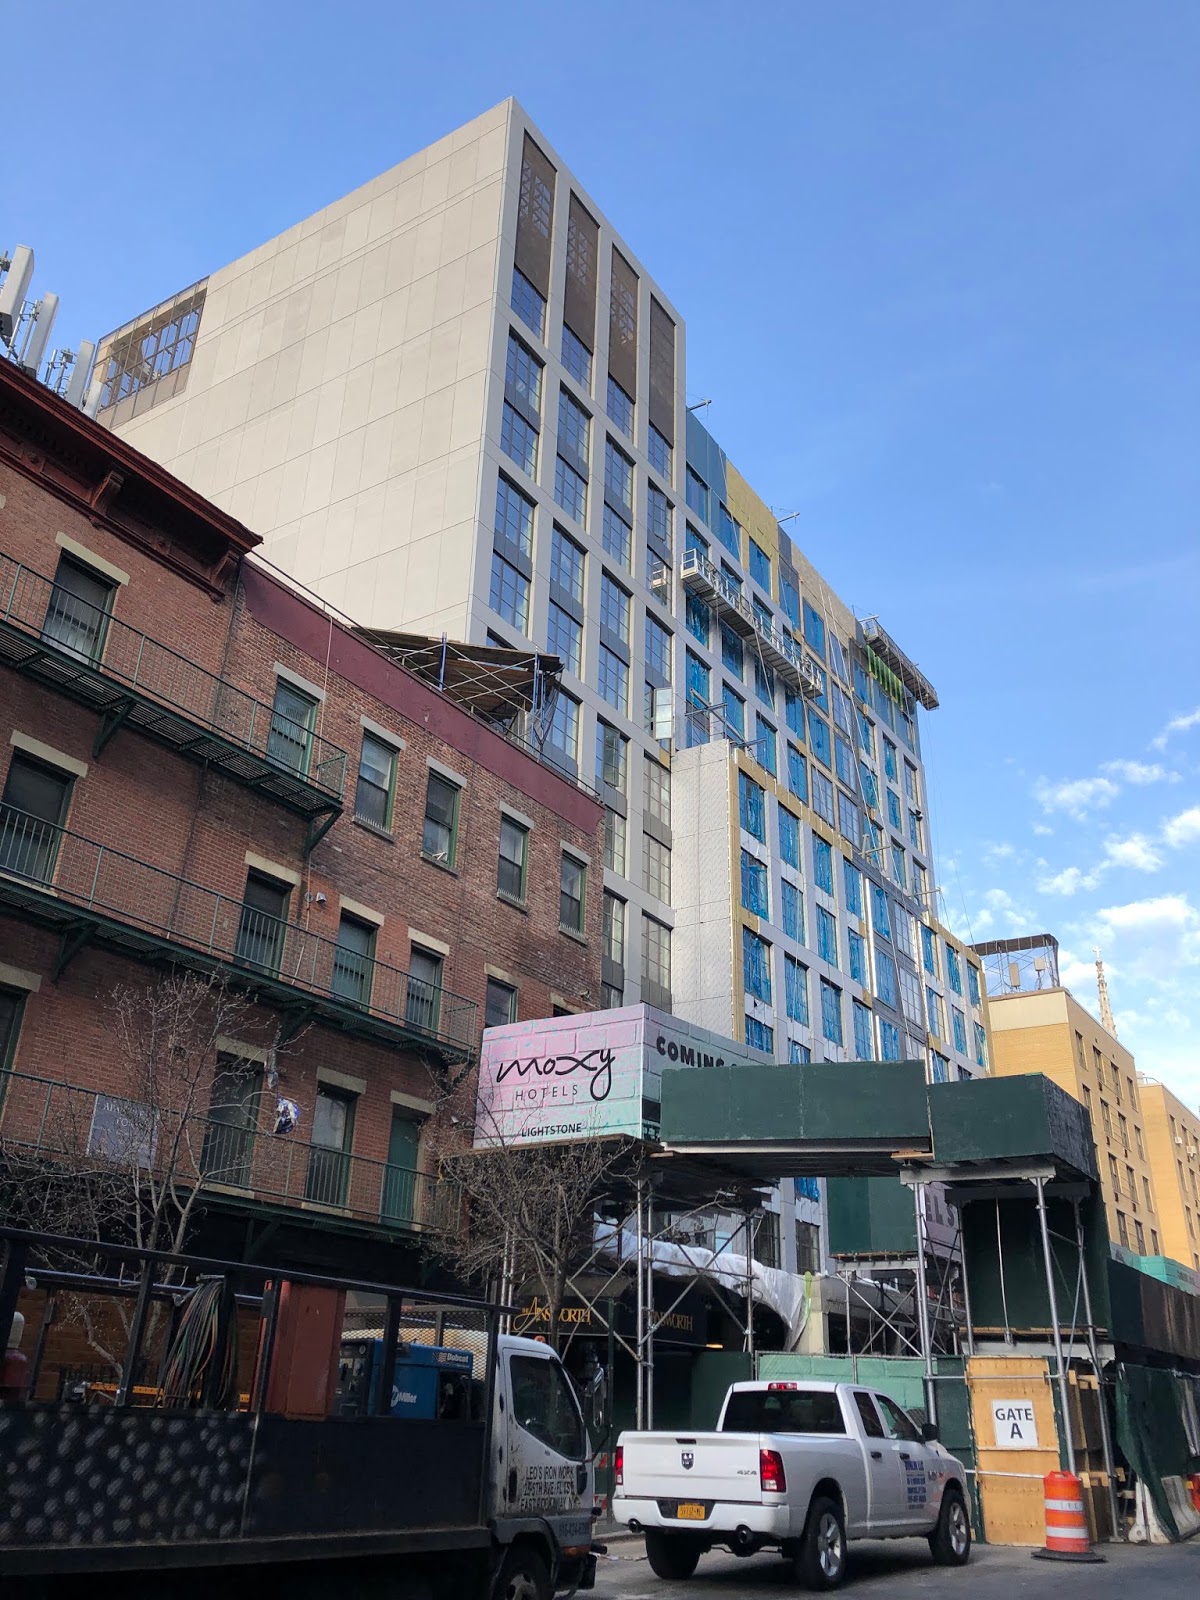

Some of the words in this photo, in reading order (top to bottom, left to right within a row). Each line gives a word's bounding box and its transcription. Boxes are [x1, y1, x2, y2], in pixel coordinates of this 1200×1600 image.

[515, 1084, 578, 1101] HOTELS
[521, 1123, 582, 1137] LIGHTSTONE
[513, 1296, 592, 1331] AINSORTH
[446, 1352, 469, 1362] Bobcat
[995, 1407, 1033, 1421] GATE
[1010, 1422, 1023, 1439] A
